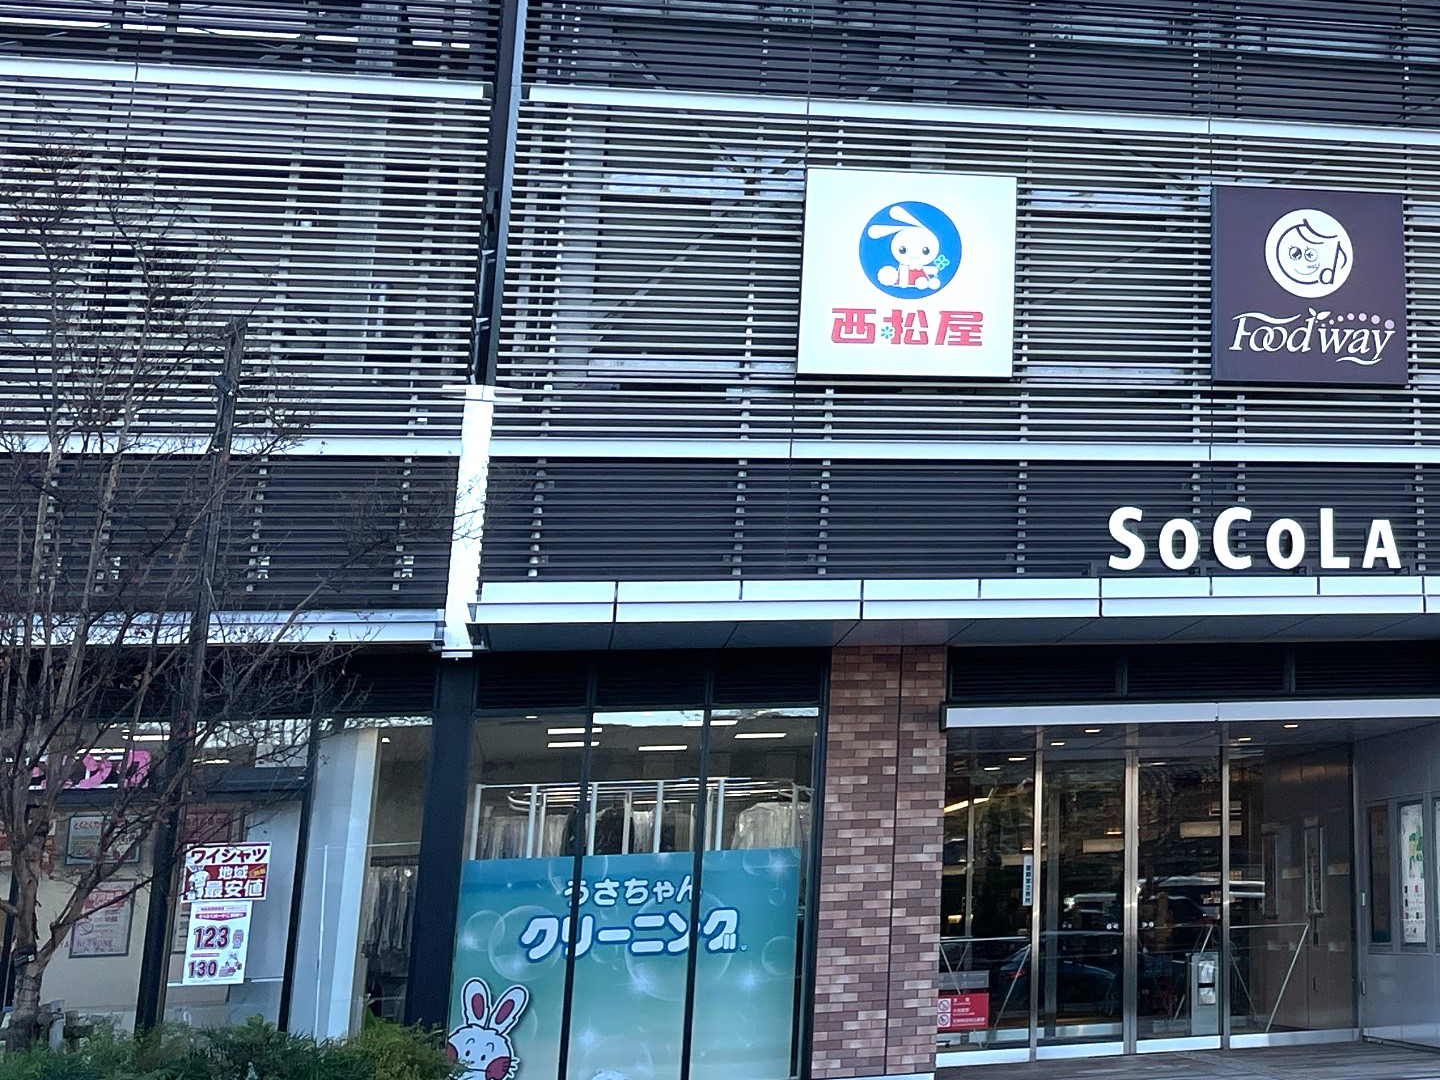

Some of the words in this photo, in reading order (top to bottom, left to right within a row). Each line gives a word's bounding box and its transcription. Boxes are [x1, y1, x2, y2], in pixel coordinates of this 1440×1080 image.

[830, 307, 984, 347] 西松屋
[191, 847, 268, 864] ワイシャツ
[217, 865, 249, 880] 地域
[204, 879, 264, 898] 最安値
[563, 875, 703, 907] うさちゃん
[194, 925, 230, 950] 123
[520, 907, 739, 961] クリーニング
[188, 959, 219, 978] 130
